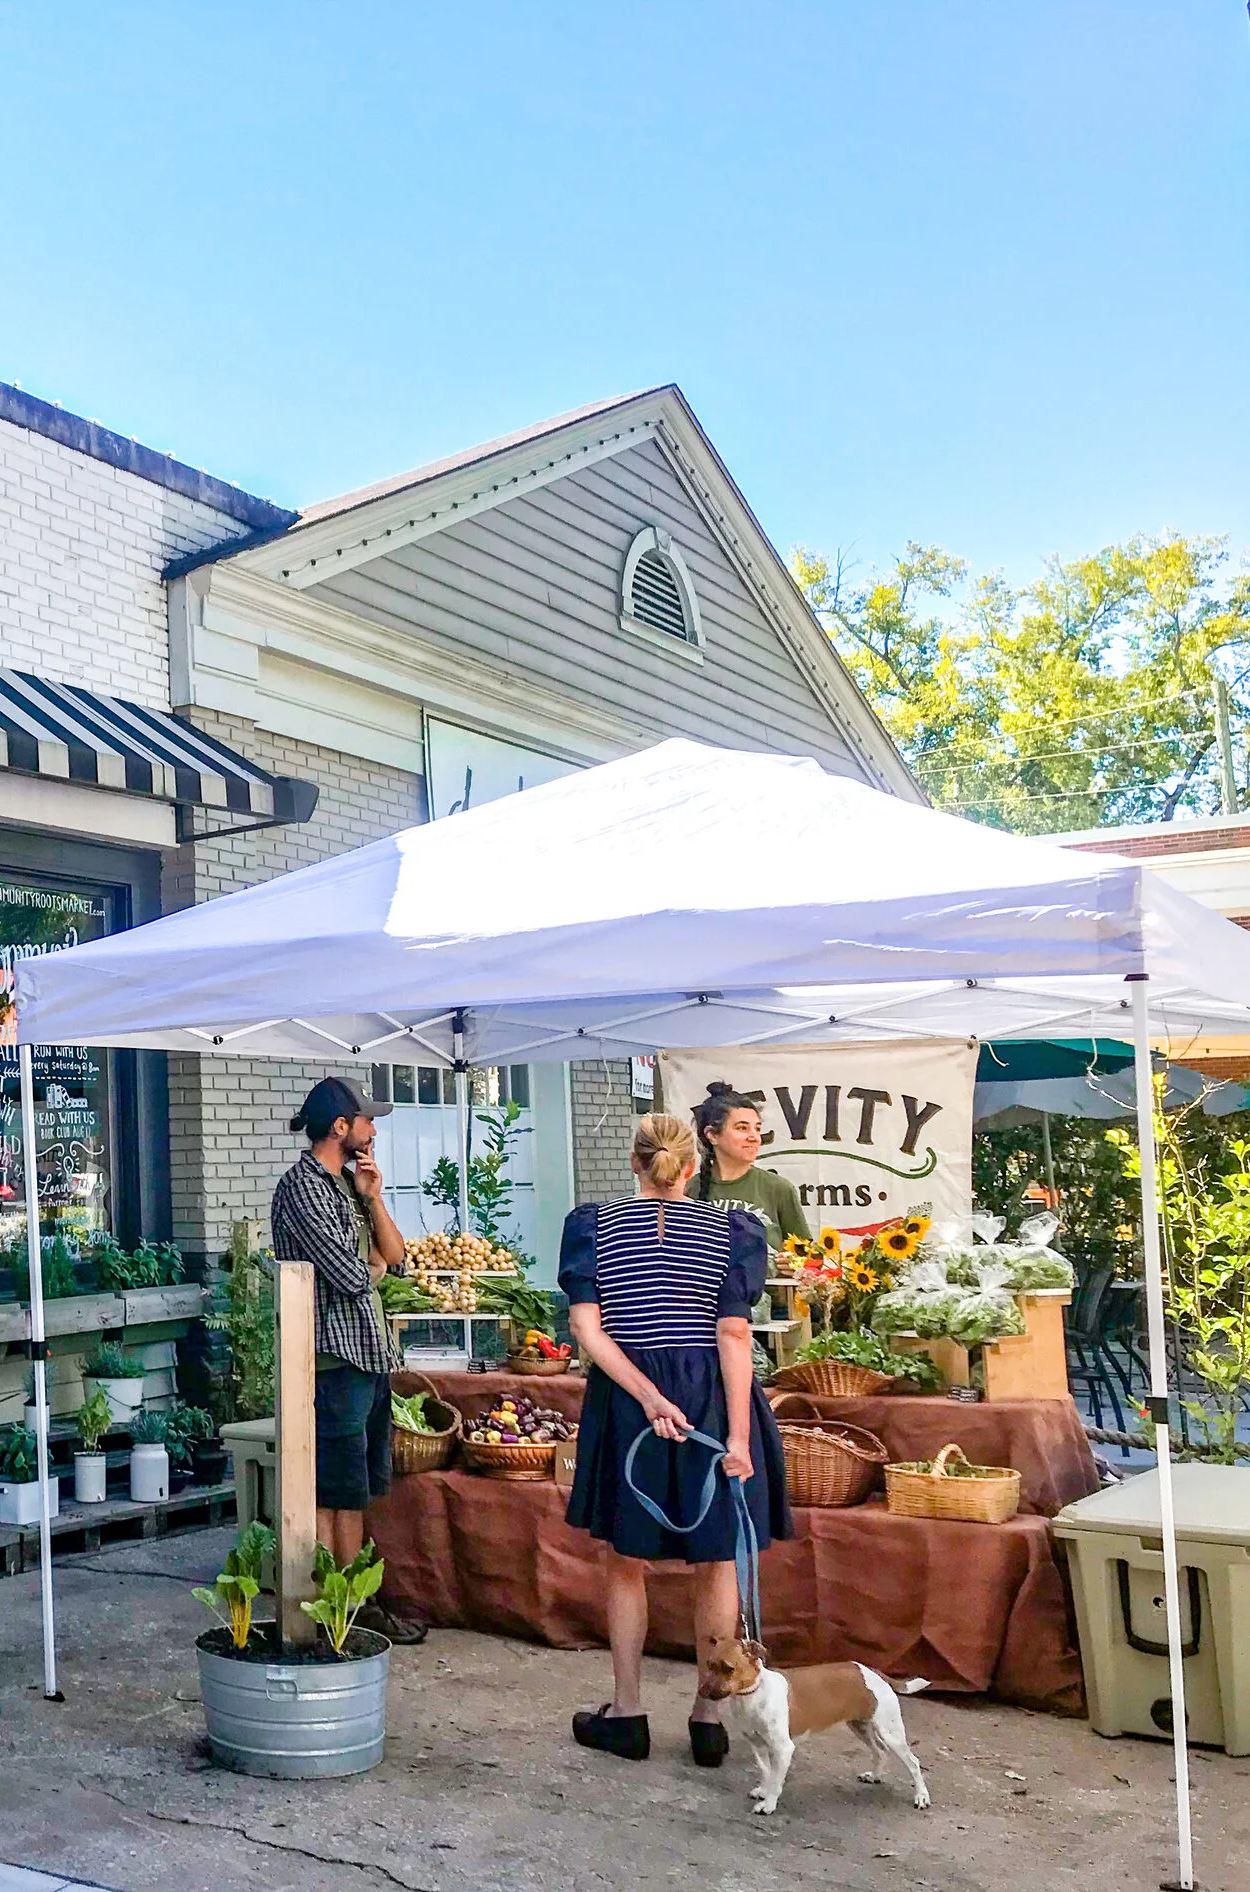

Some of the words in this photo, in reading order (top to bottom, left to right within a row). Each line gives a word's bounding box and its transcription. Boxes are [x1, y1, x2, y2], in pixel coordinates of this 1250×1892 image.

[33, 1045, 52, 1059] RUN
[55, 1046, 74, 1059] WITH
[77, 1046, 88, 1060] US
[34, 1112, 55, 1126] READ
[58, 1111, 81, 1124] WITH
[83, 1111, 95, 1125] US
[37, 1173, 70, 1197] Learn
